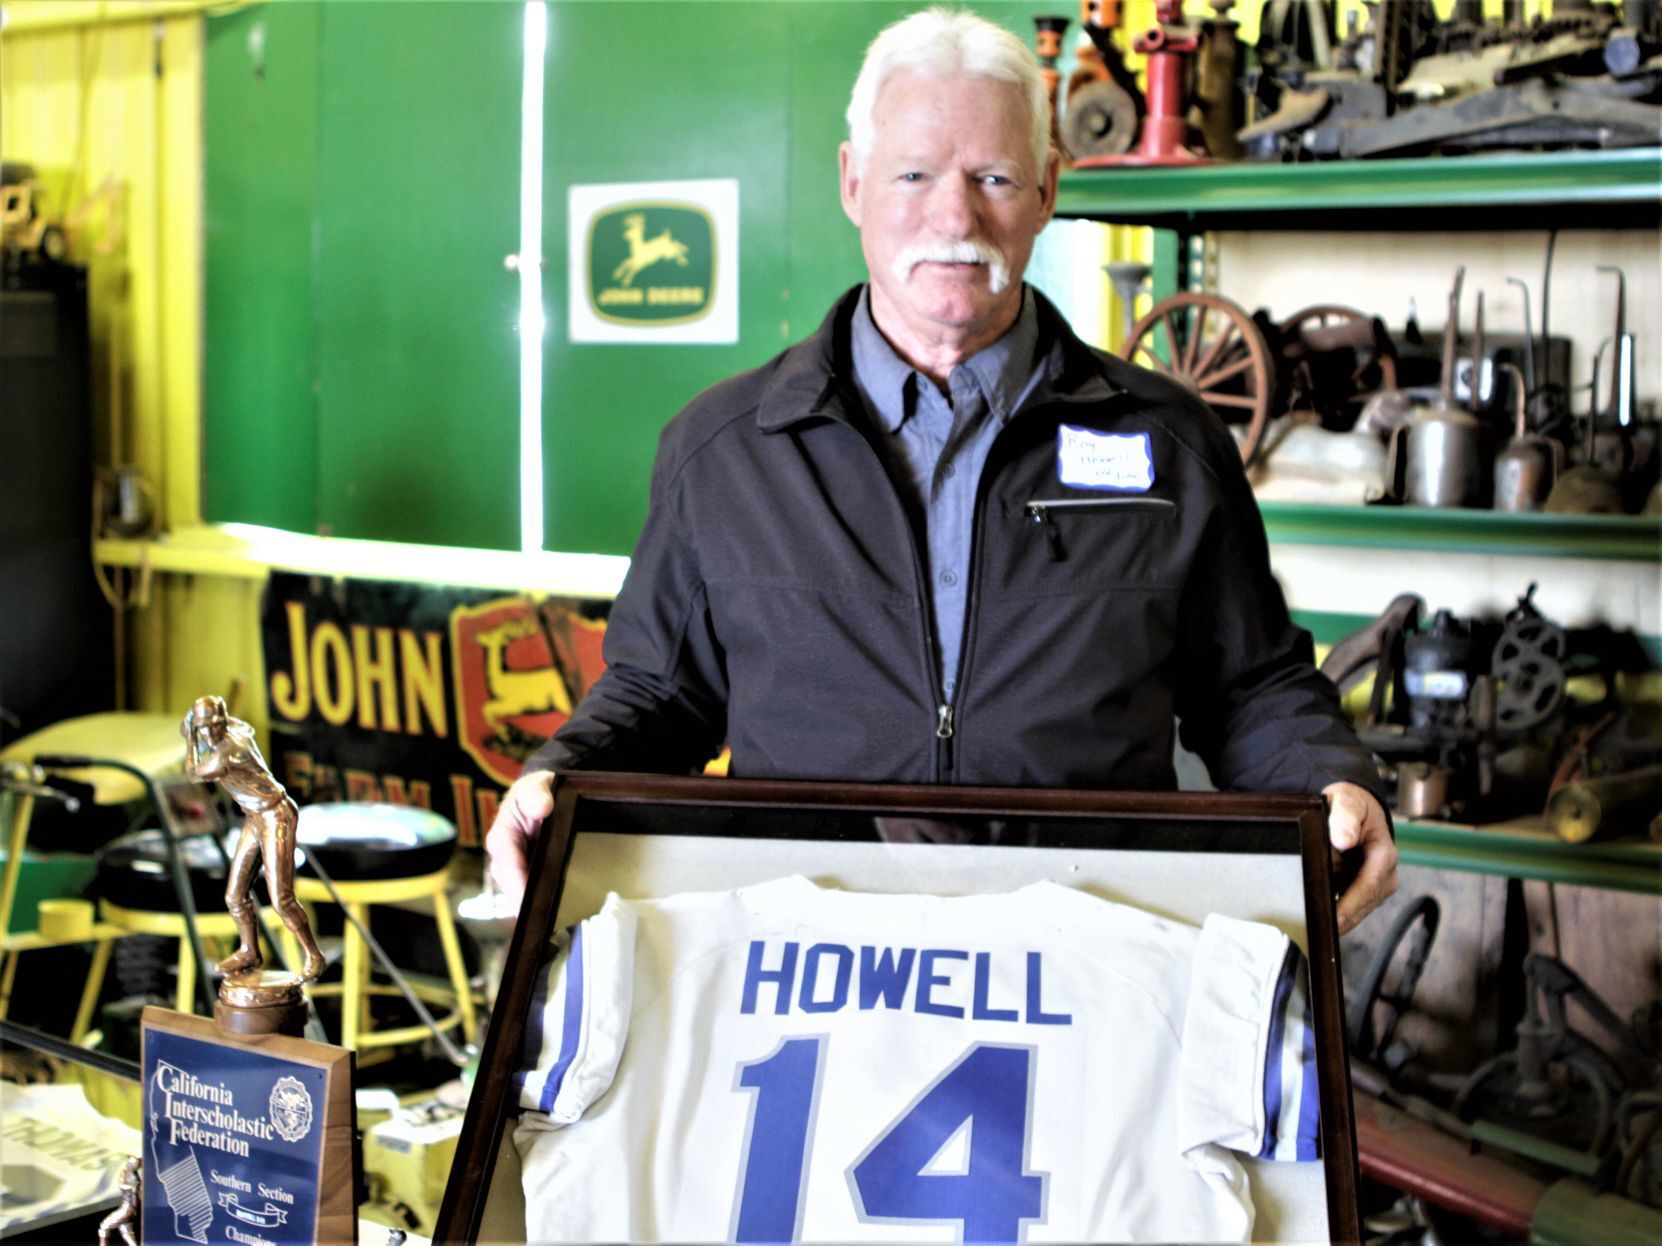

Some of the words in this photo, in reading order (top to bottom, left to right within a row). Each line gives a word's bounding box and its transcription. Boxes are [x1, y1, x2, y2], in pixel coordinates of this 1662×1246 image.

[270, 601, 448, 738] JOHN
[740, 940, 1073, 1026] HOWELL
[157, 1065, 233, 1106] California
[164, 1090, 275, 1140] Interscholastic
[169, 1118, 249, 1158] Federation
[726, 1032, 1051, 1246] 14
[210, 1169, 252, 1193] Southern
[257, 1182, 294, 1205] Section
